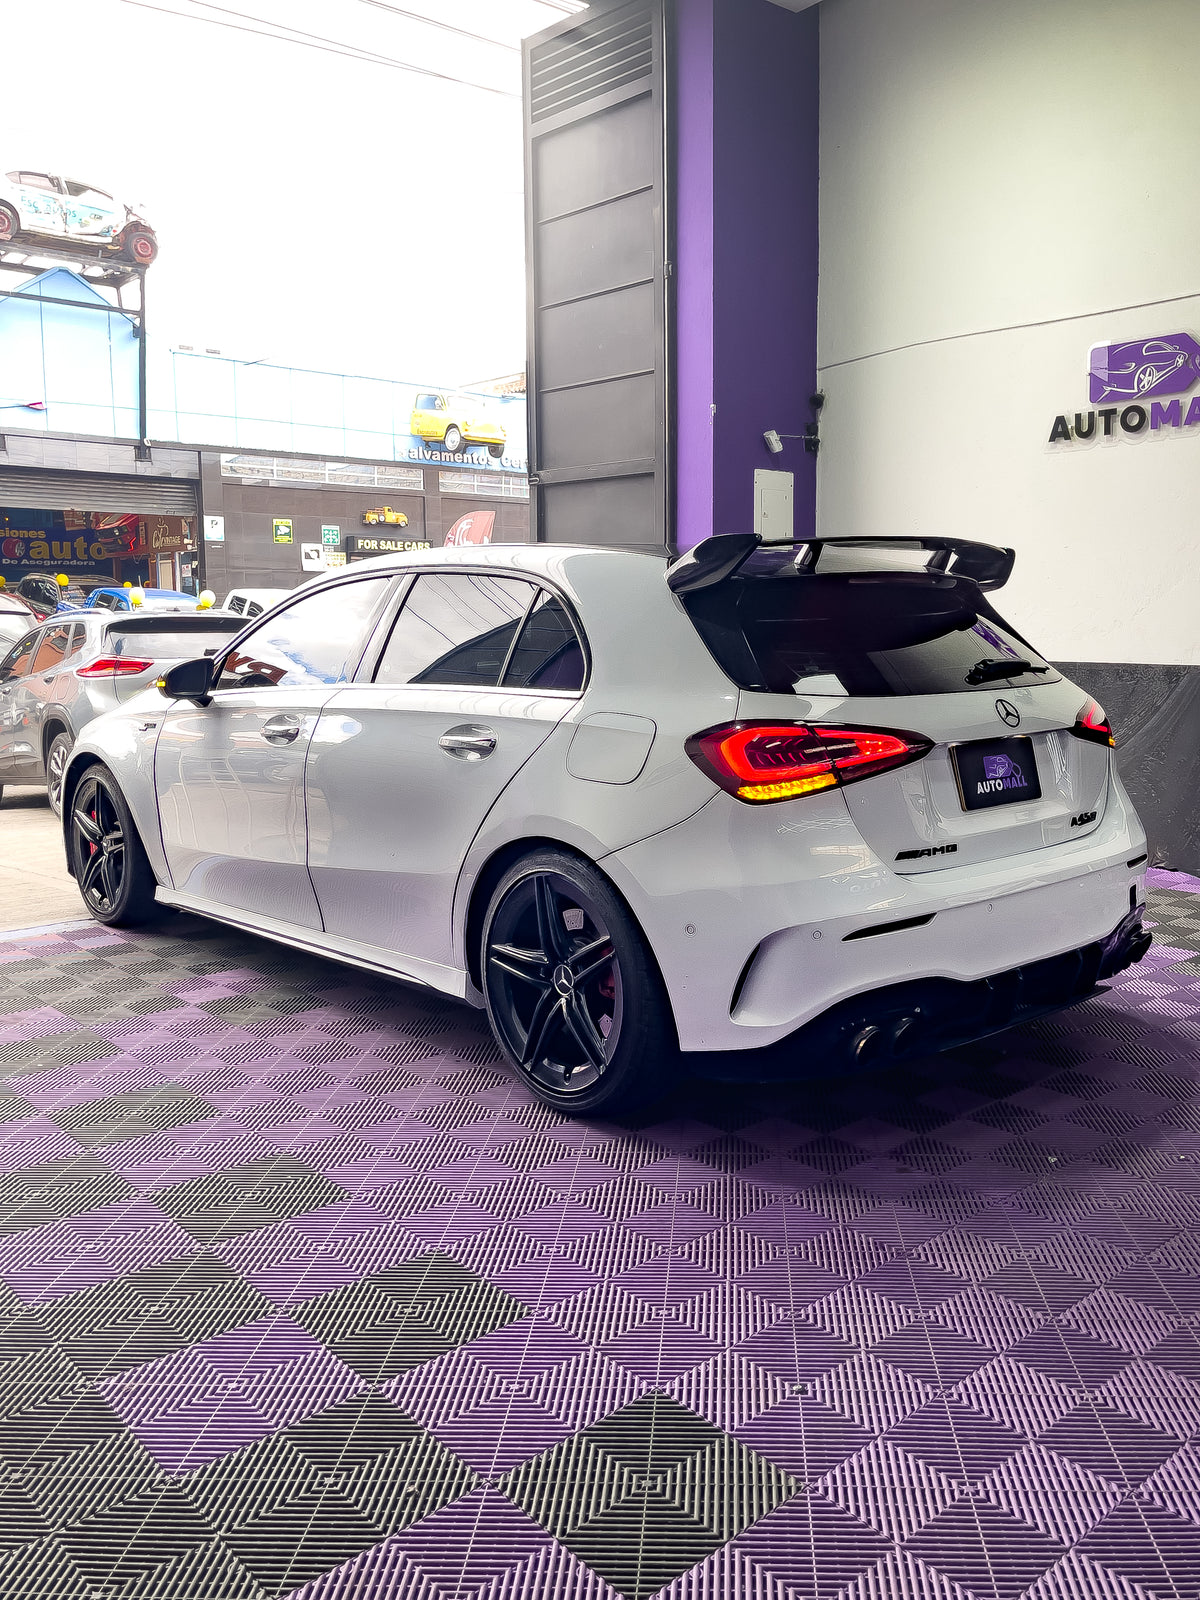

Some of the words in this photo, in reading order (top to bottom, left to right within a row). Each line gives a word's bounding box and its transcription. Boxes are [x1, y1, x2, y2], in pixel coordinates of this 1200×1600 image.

[29, 536, 107, 560] auto
[357, 539, 378, 550] FOR
[379, 540, 404, 551] SALE
[404, 541, 431, 551] CARS
[21, 558, 96, 566] Aseguradora
[977, 775, 1028, 794] AUTOMALL
[918, 843, 958, 858] AMG
